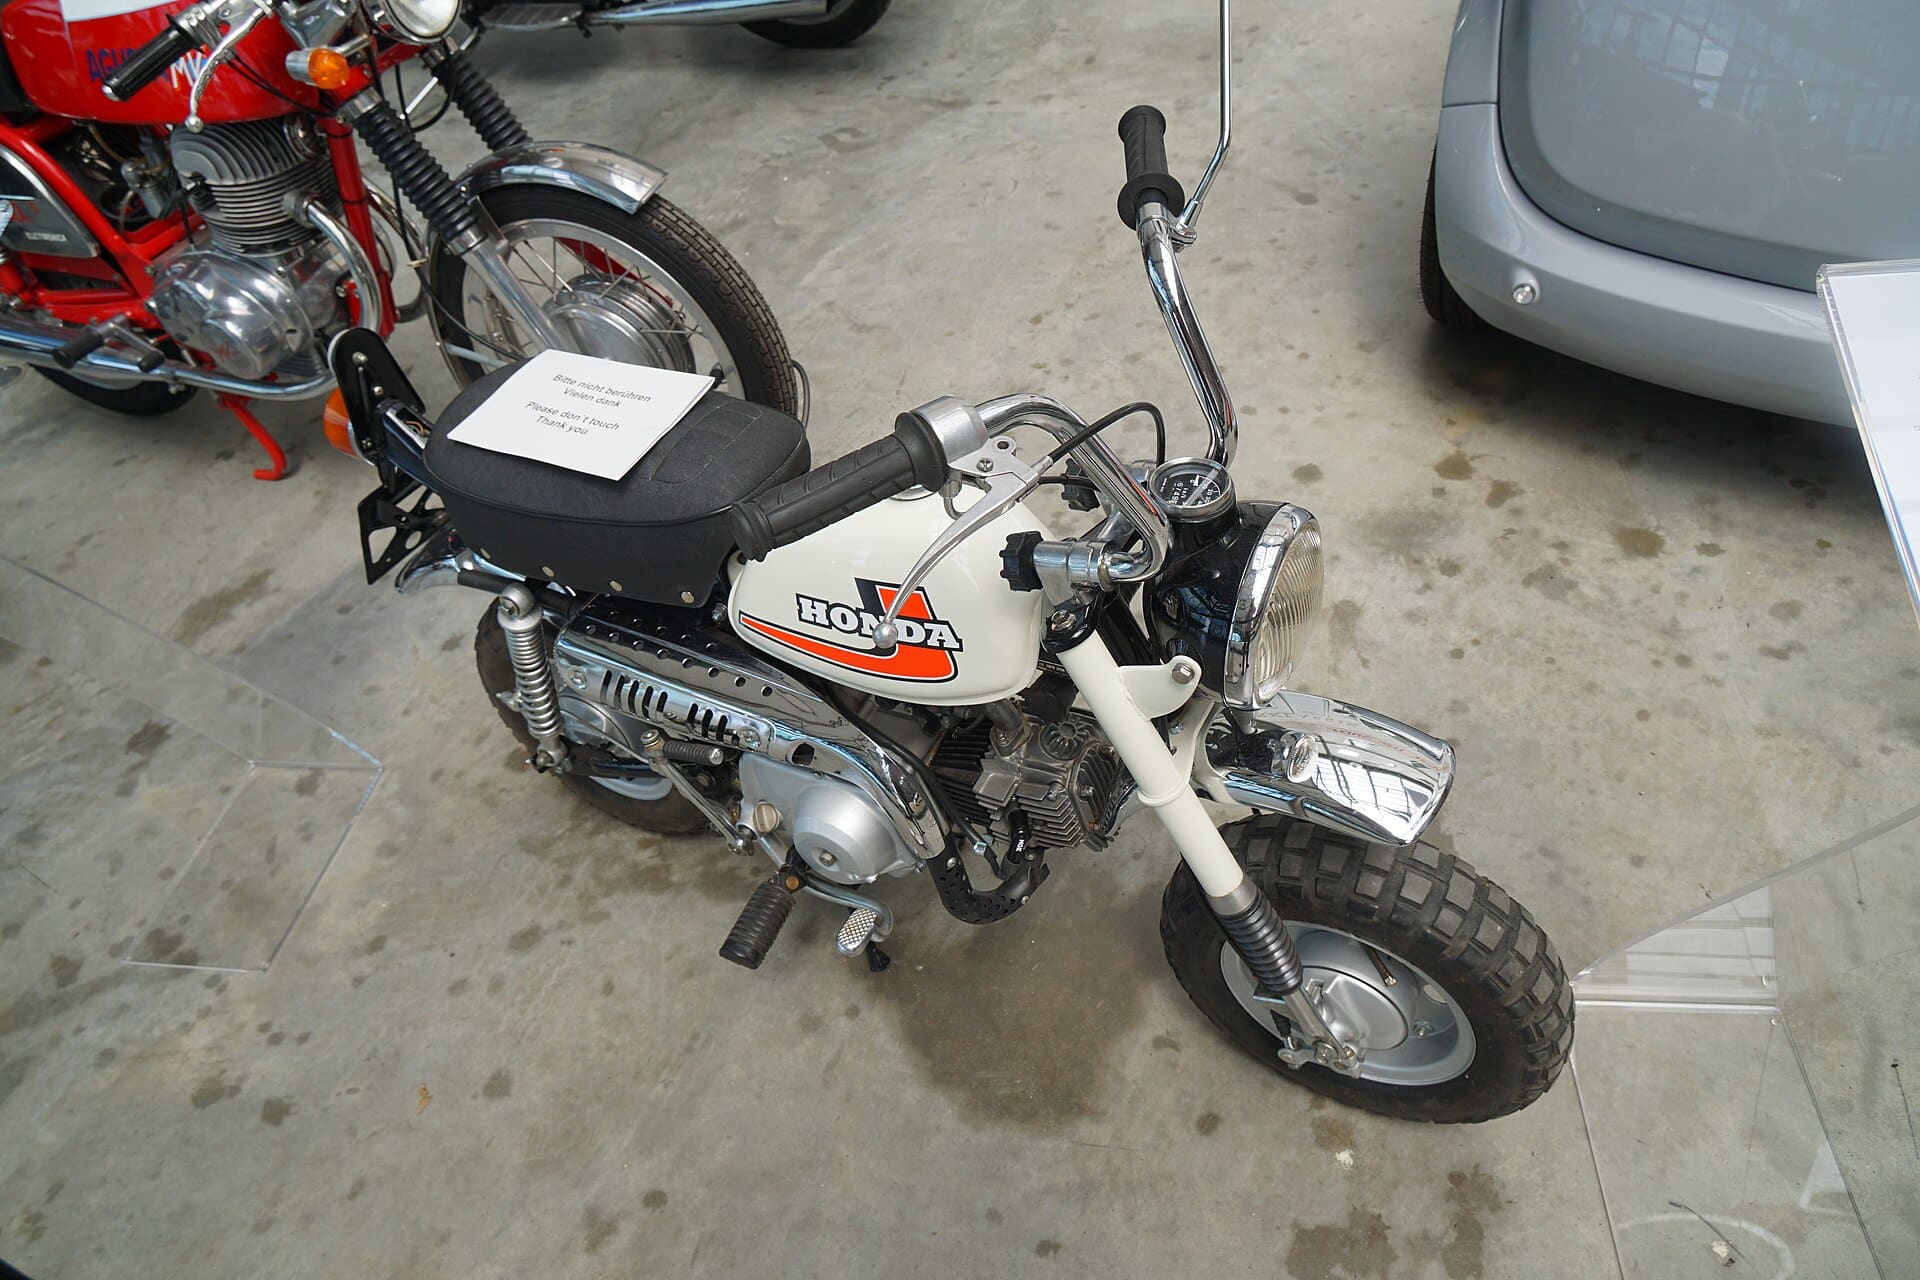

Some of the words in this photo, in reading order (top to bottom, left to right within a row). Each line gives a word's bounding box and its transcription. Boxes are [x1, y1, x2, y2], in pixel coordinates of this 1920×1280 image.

[553, 374, 577, 386] Bitte
[577, 381, 605, 393] nicht
[605, 388, 651, 402] berühren
[564, 387, 594, 401] Vielen
[595, 396, 621, 408] dank
[525, 401, 560, 415] Please
[589, 417, 621, 431] touch
[536, 415, 567, 430] Thank
[567, 425, 588, 435] you
[796, 594, 963, 652] HONDA
